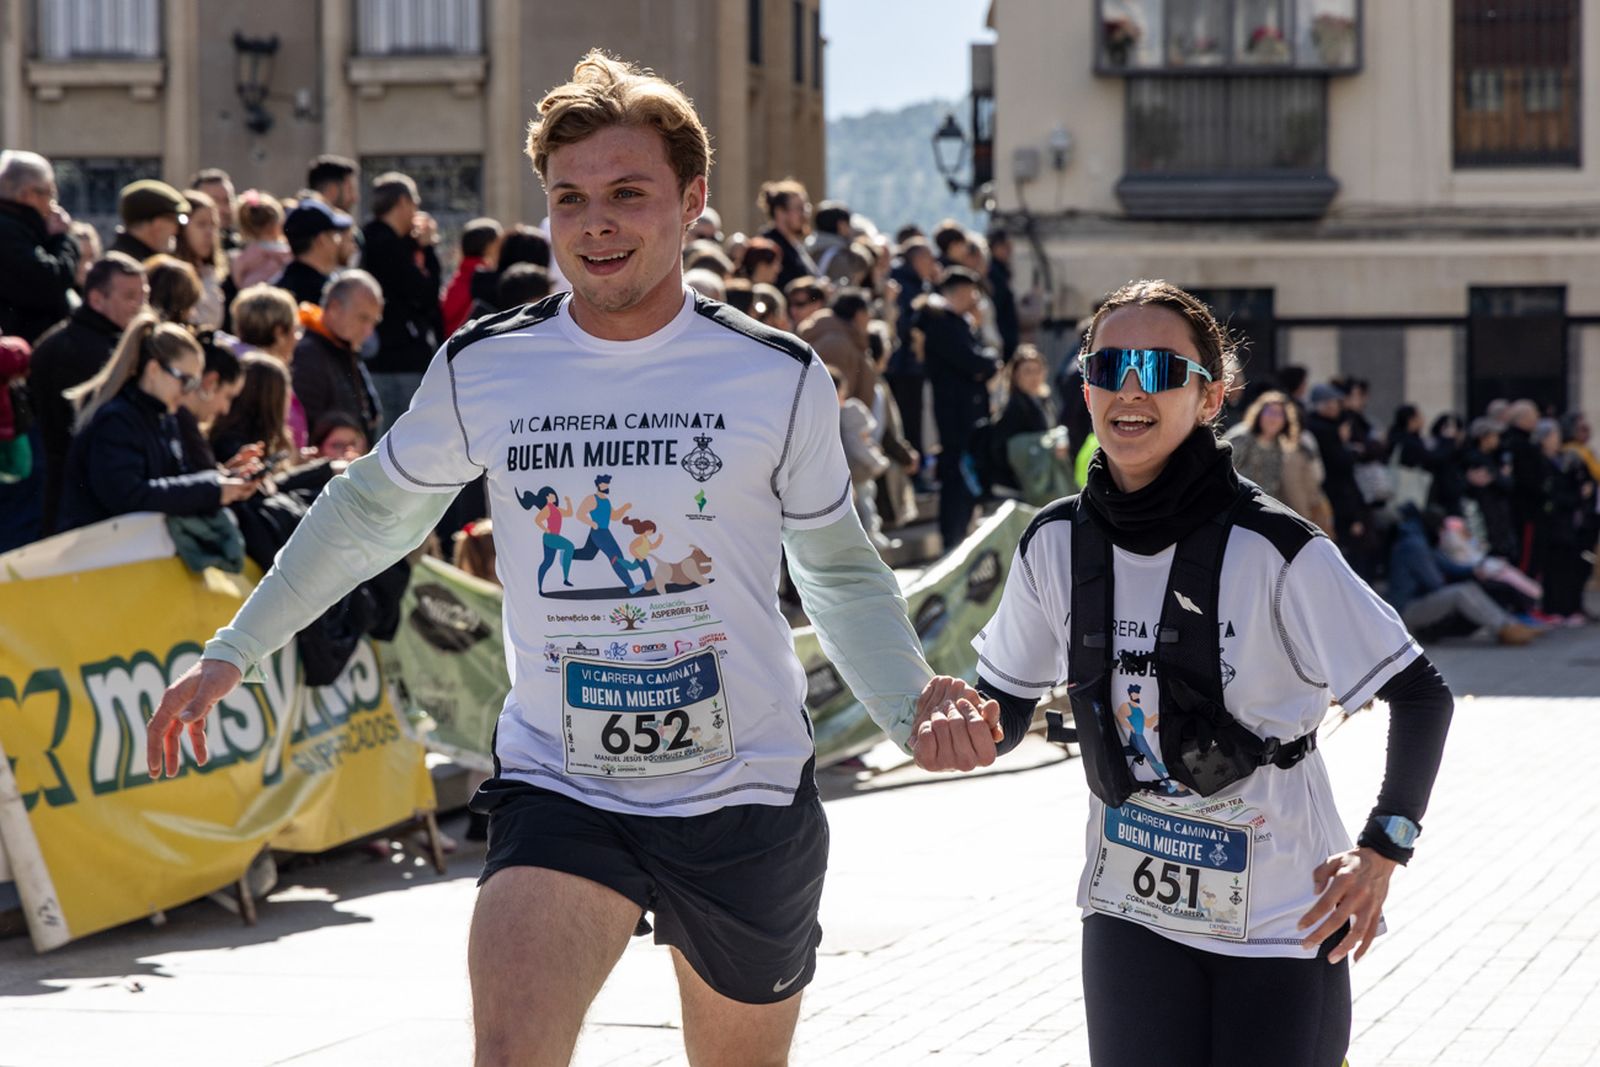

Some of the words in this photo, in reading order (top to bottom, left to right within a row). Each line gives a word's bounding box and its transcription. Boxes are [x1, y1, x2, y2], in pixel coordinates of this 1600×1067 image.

[510, 418, 524, 434] VI
[528, 413, 618, 432] CARRERA
[624, 412, 726, 430] CAMINATA
[507, 442, 574, 472] BUENA
[584, 440, 678, 467] MUERTE
[547, 614, 555, 622] En
[651, 604, 710, 619] ASPERGER-TEA
[581, 668, 592, 680] VI
[593, 670, 644, 685] CARRERA
[646, 661, 702, 685] CAMINATA
[581, 686, 622, 707] BUENA
[626, 687, 681, 707] MUERTE
[601, 709, 693, 755] 652
[594, 753, 621, 763] MANUEL
[1120, 807, 1129, 817] VI
[1131, 809, 1171, 831] CARRERA
[1174, 822, 1230, 843] CAMINATA
[1118, 822, 1151, 849] BUENA
[1153, 834, 1203, 861] MUERTE
[1133, 856, 1200, 909] 651
[1126, 894, 1146, 905] CORAL
[1146, 899, 1173, 913] HIDALGO
